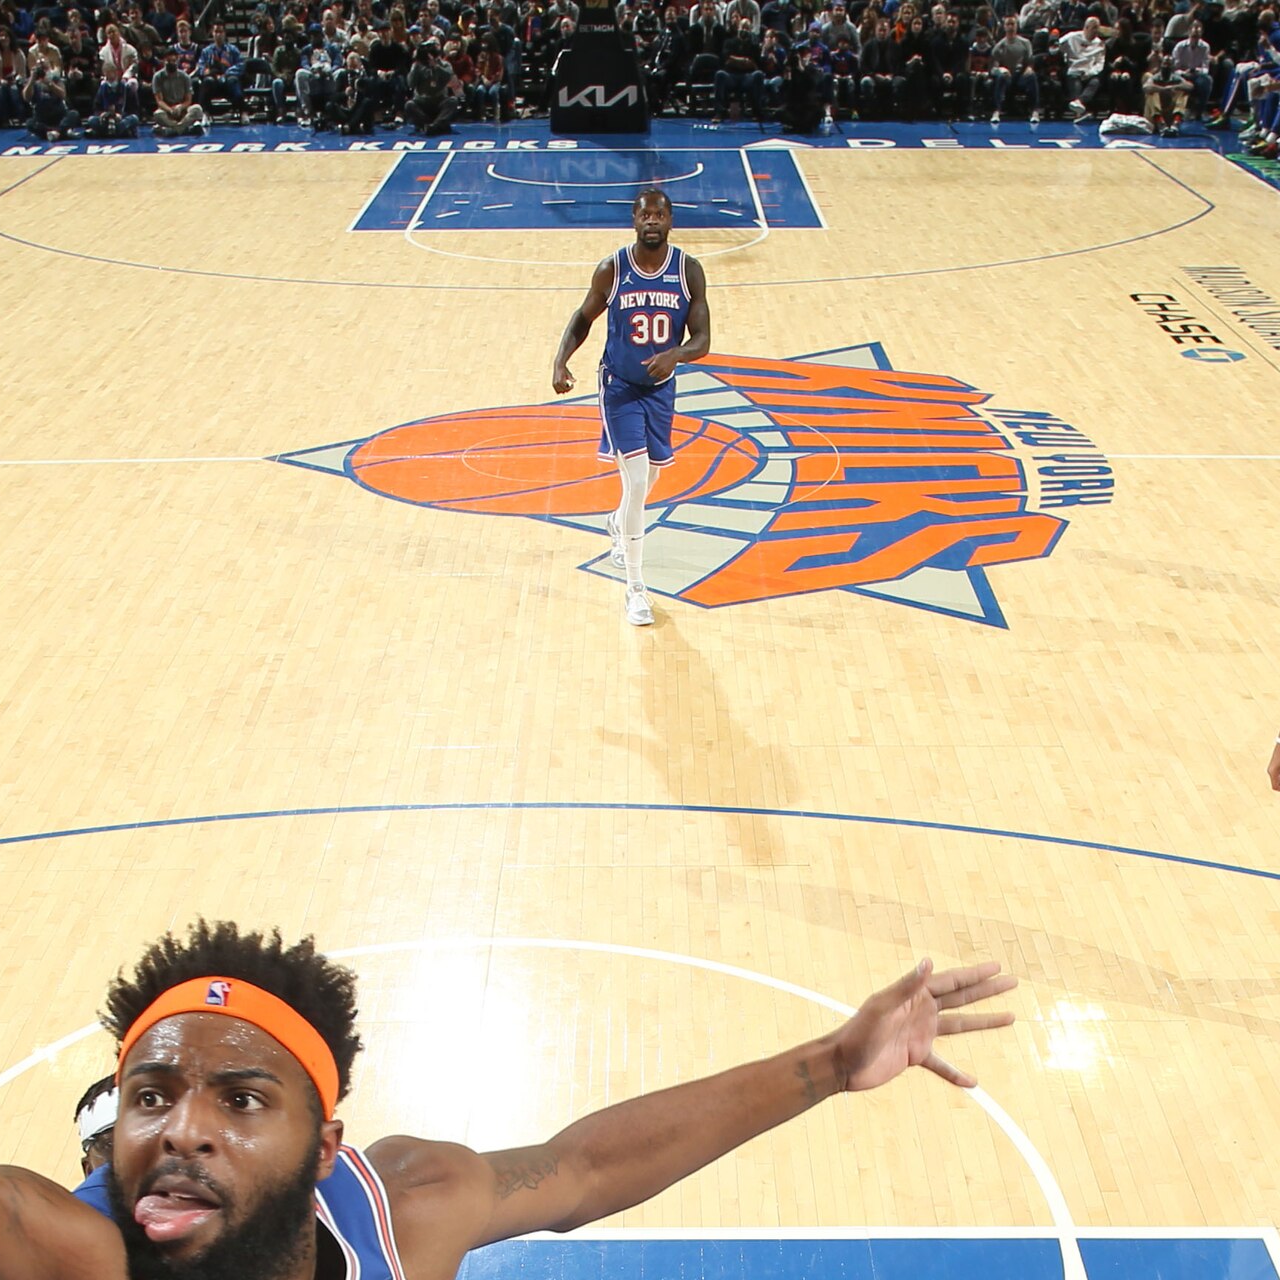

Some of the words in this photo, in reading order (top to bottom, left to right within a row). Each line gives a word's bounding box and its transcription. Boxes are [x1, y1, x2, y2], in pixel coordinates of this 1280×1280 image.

[558, 85, 638, 107] KIA
[2, 143, 130, 156] NEW
[157, 142, 312, 154] YORK
[348, 139, 578, 151] KNICKS
[846, 138, 1156, 150] DELTA
[619, 291, 648, 310] NEW
[647, 290, 681, 310] YORK
[1179, 265, 1280, 308] MADISON
[629, 311, 672, 347] 30
[1129, 293, 1225, 345] CHASE
[982, 406, 1098, 449] NEW
[682, 352, 1070, 610] KNICKS
[1031, 453, 1116, 509] YORK
